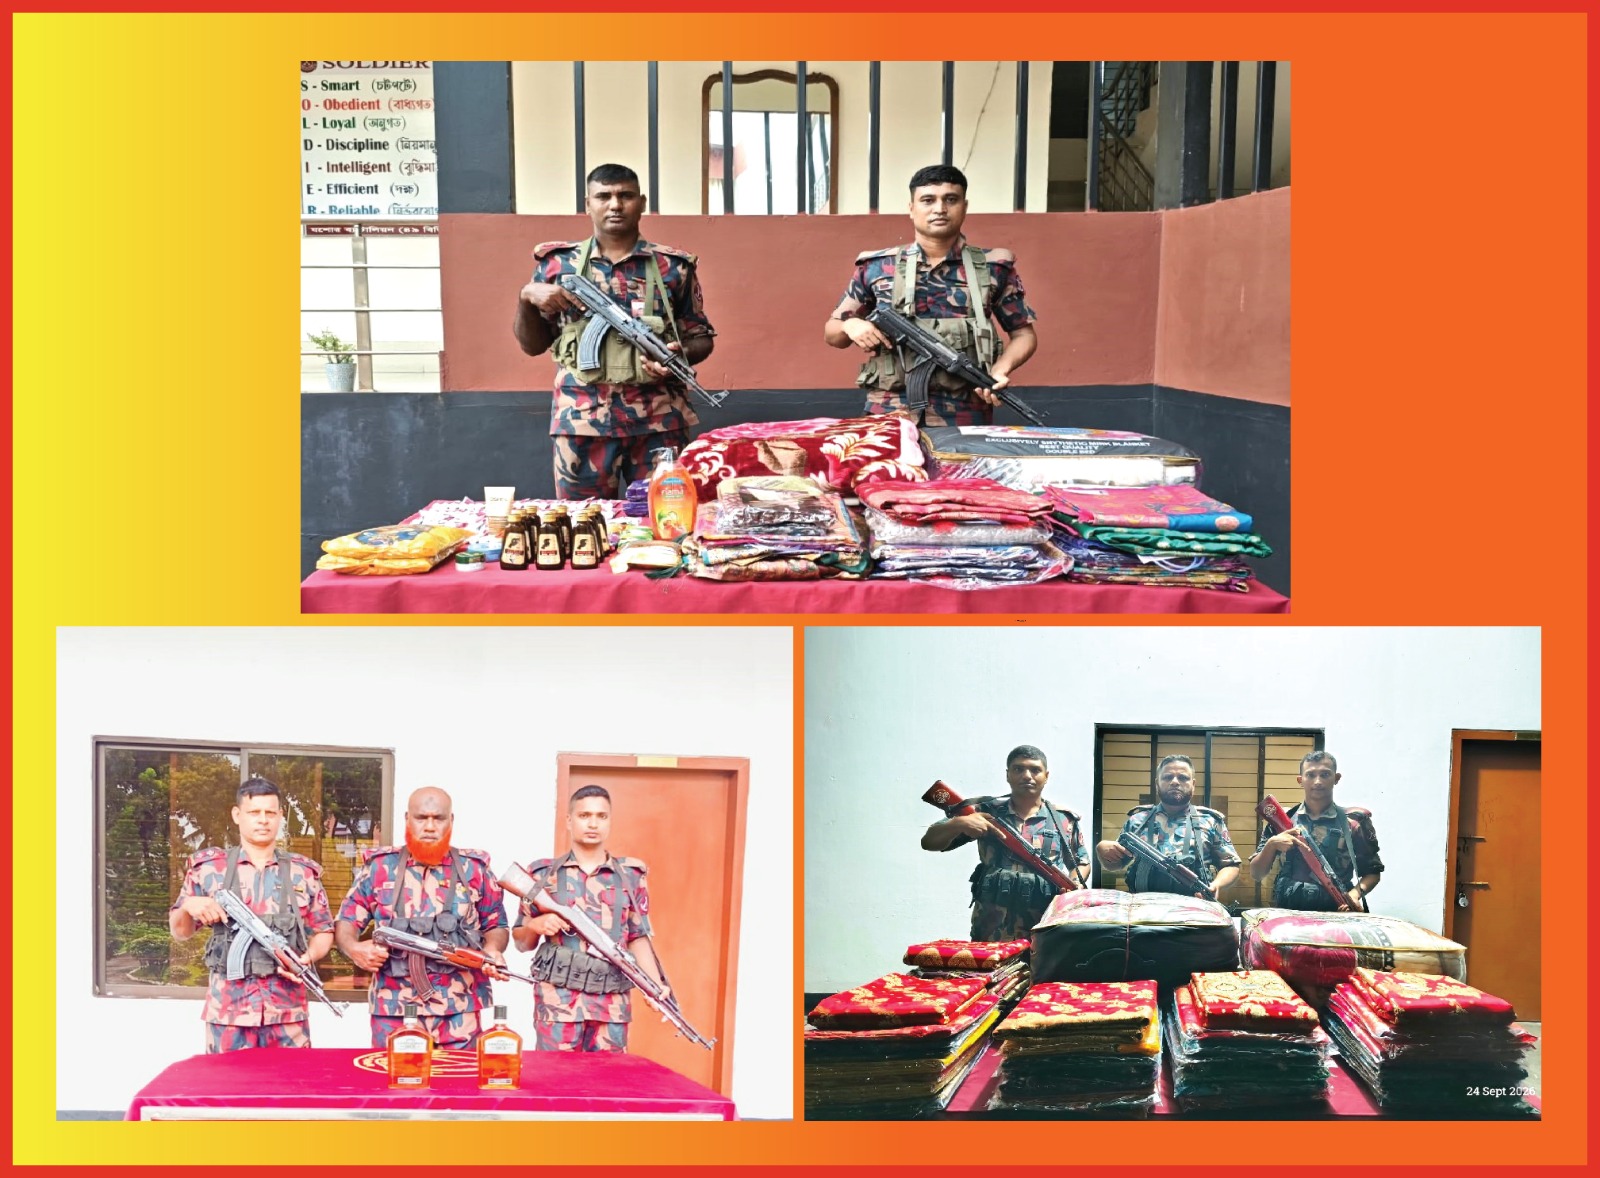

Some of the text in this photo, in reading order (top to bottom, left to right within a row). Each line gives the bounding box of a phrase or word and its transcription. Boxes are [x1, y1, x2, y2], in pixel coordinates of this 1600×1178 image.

[301, 80, 309, 91] S
[321, 80, 360, 91] Smart
[301, 99, 311, 110] O
[323, 99, 380, 110] Obedient
[302, 117, 311, 129] L
[322, 117, 356, 131] Loyal
[304, 139, 313, 150] D
[326, 138, 389, 152] Discipline
[305, 162, 310, 173] I
[326, 161, 392, 175] Intelligent
[307, 183, 314, 194] E
[327, 183, 379, 194] Efficient
[307, 205, 317, 214] R
[328, 205, 380, 214] Reliable
[985, 437, 1039, 445] EXCLUSIVELY
